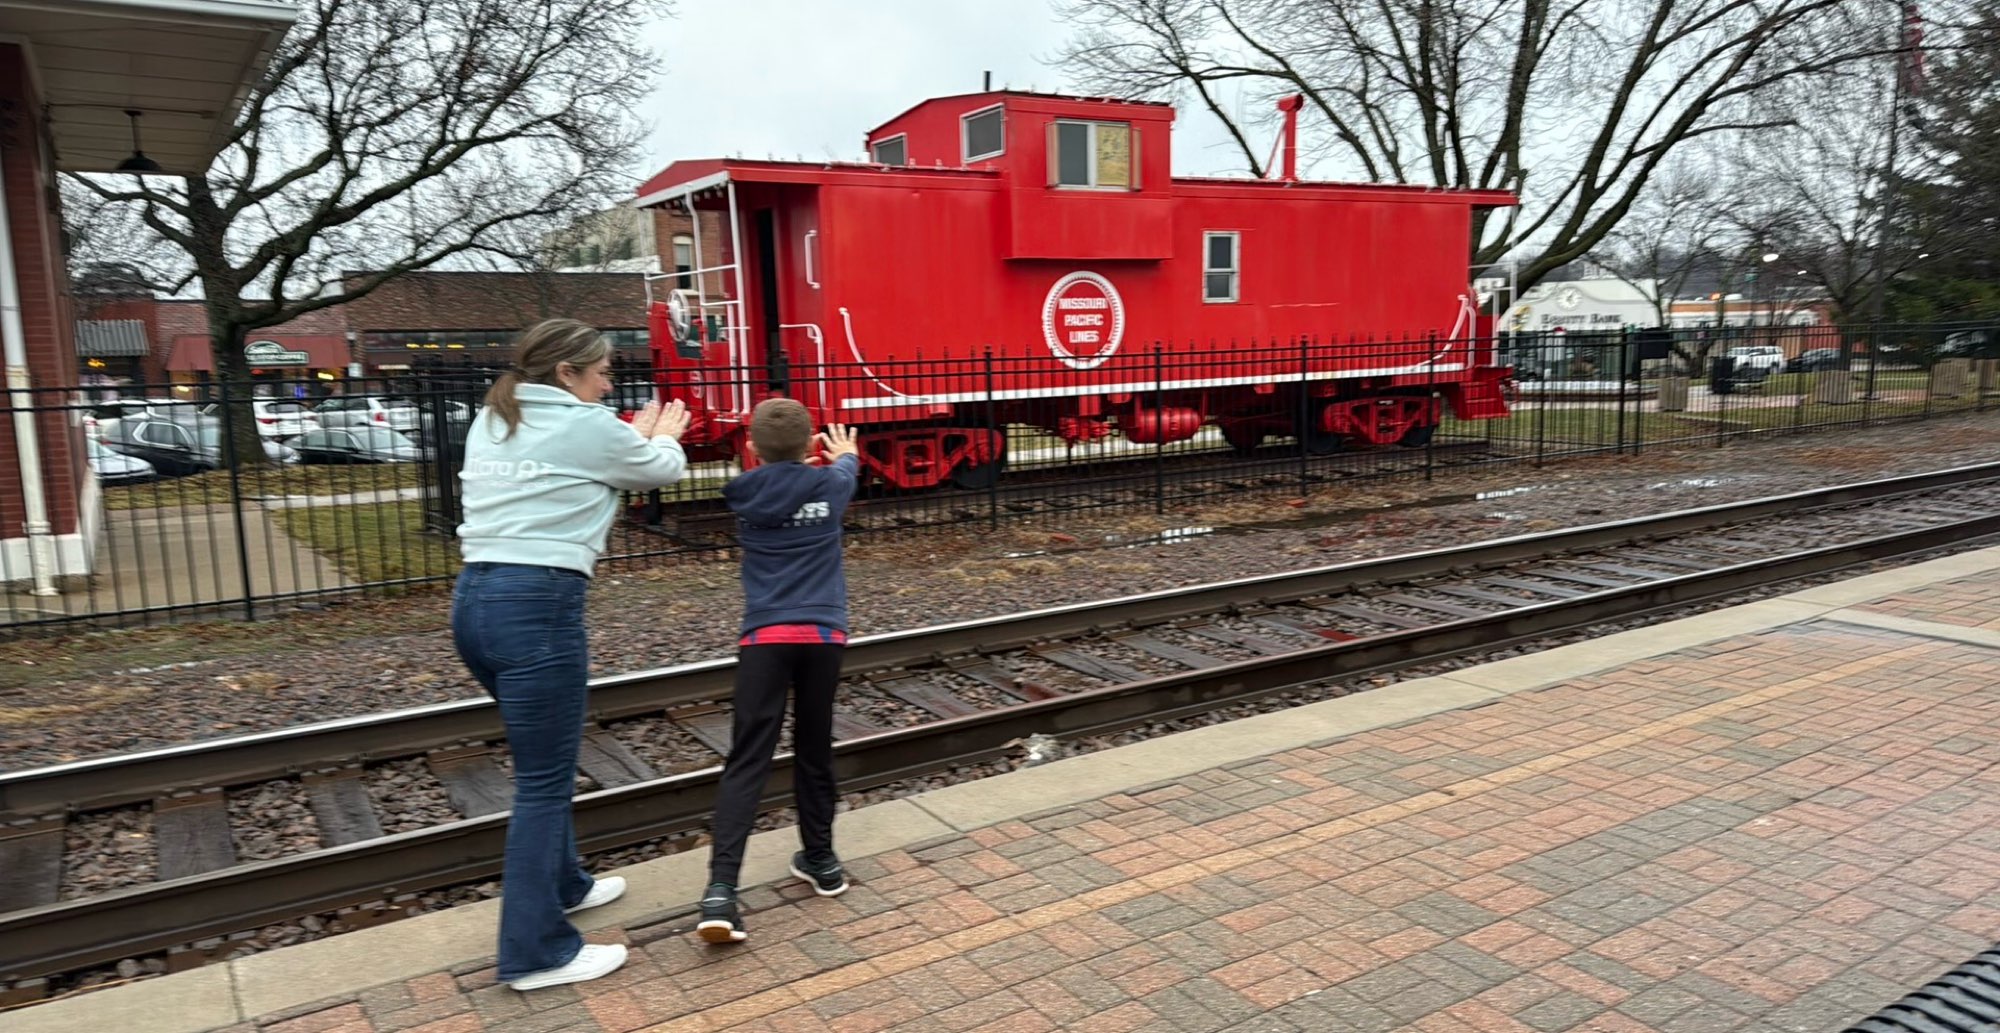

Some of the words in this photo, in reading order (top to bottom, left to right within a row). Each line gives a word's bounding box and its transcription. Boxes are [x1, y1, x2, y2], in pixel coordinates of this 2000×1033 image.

[1059, 298, 1107, 309] MISSOURI
[1064, 314, 1104, 326] PACIFIC
[1069, 331, 1099, 343] LINES
